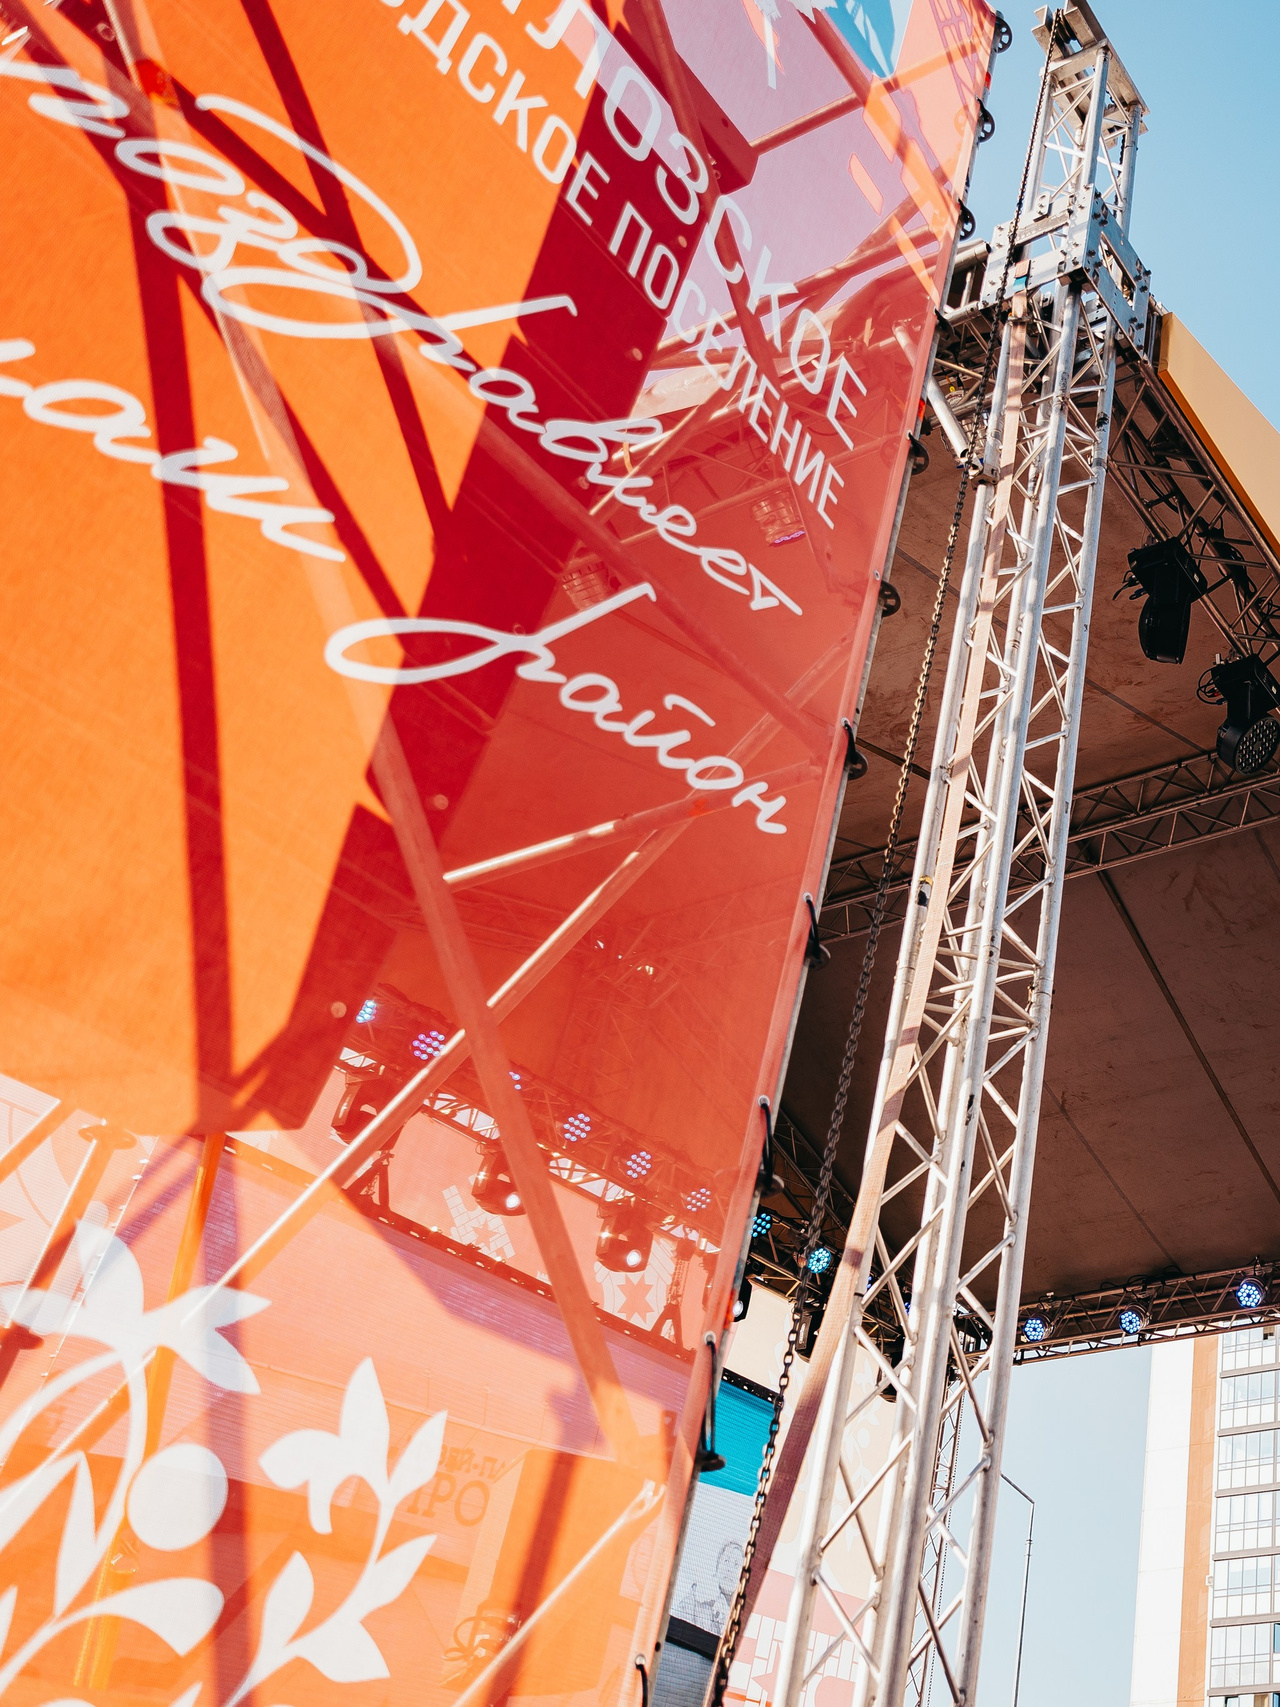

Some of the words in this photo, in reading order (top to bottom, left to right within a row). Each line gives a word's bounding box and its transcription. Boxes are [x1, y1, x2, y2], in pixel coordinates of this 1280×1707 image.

[378, 0, 611, 227] ДСКОЕ
[608, 201, 845, 530] ПОСЕЛЕНИЕ
[503, 0, 867, 451] ЛОЗСКОЕ
[325, 583, 786, 835] район
